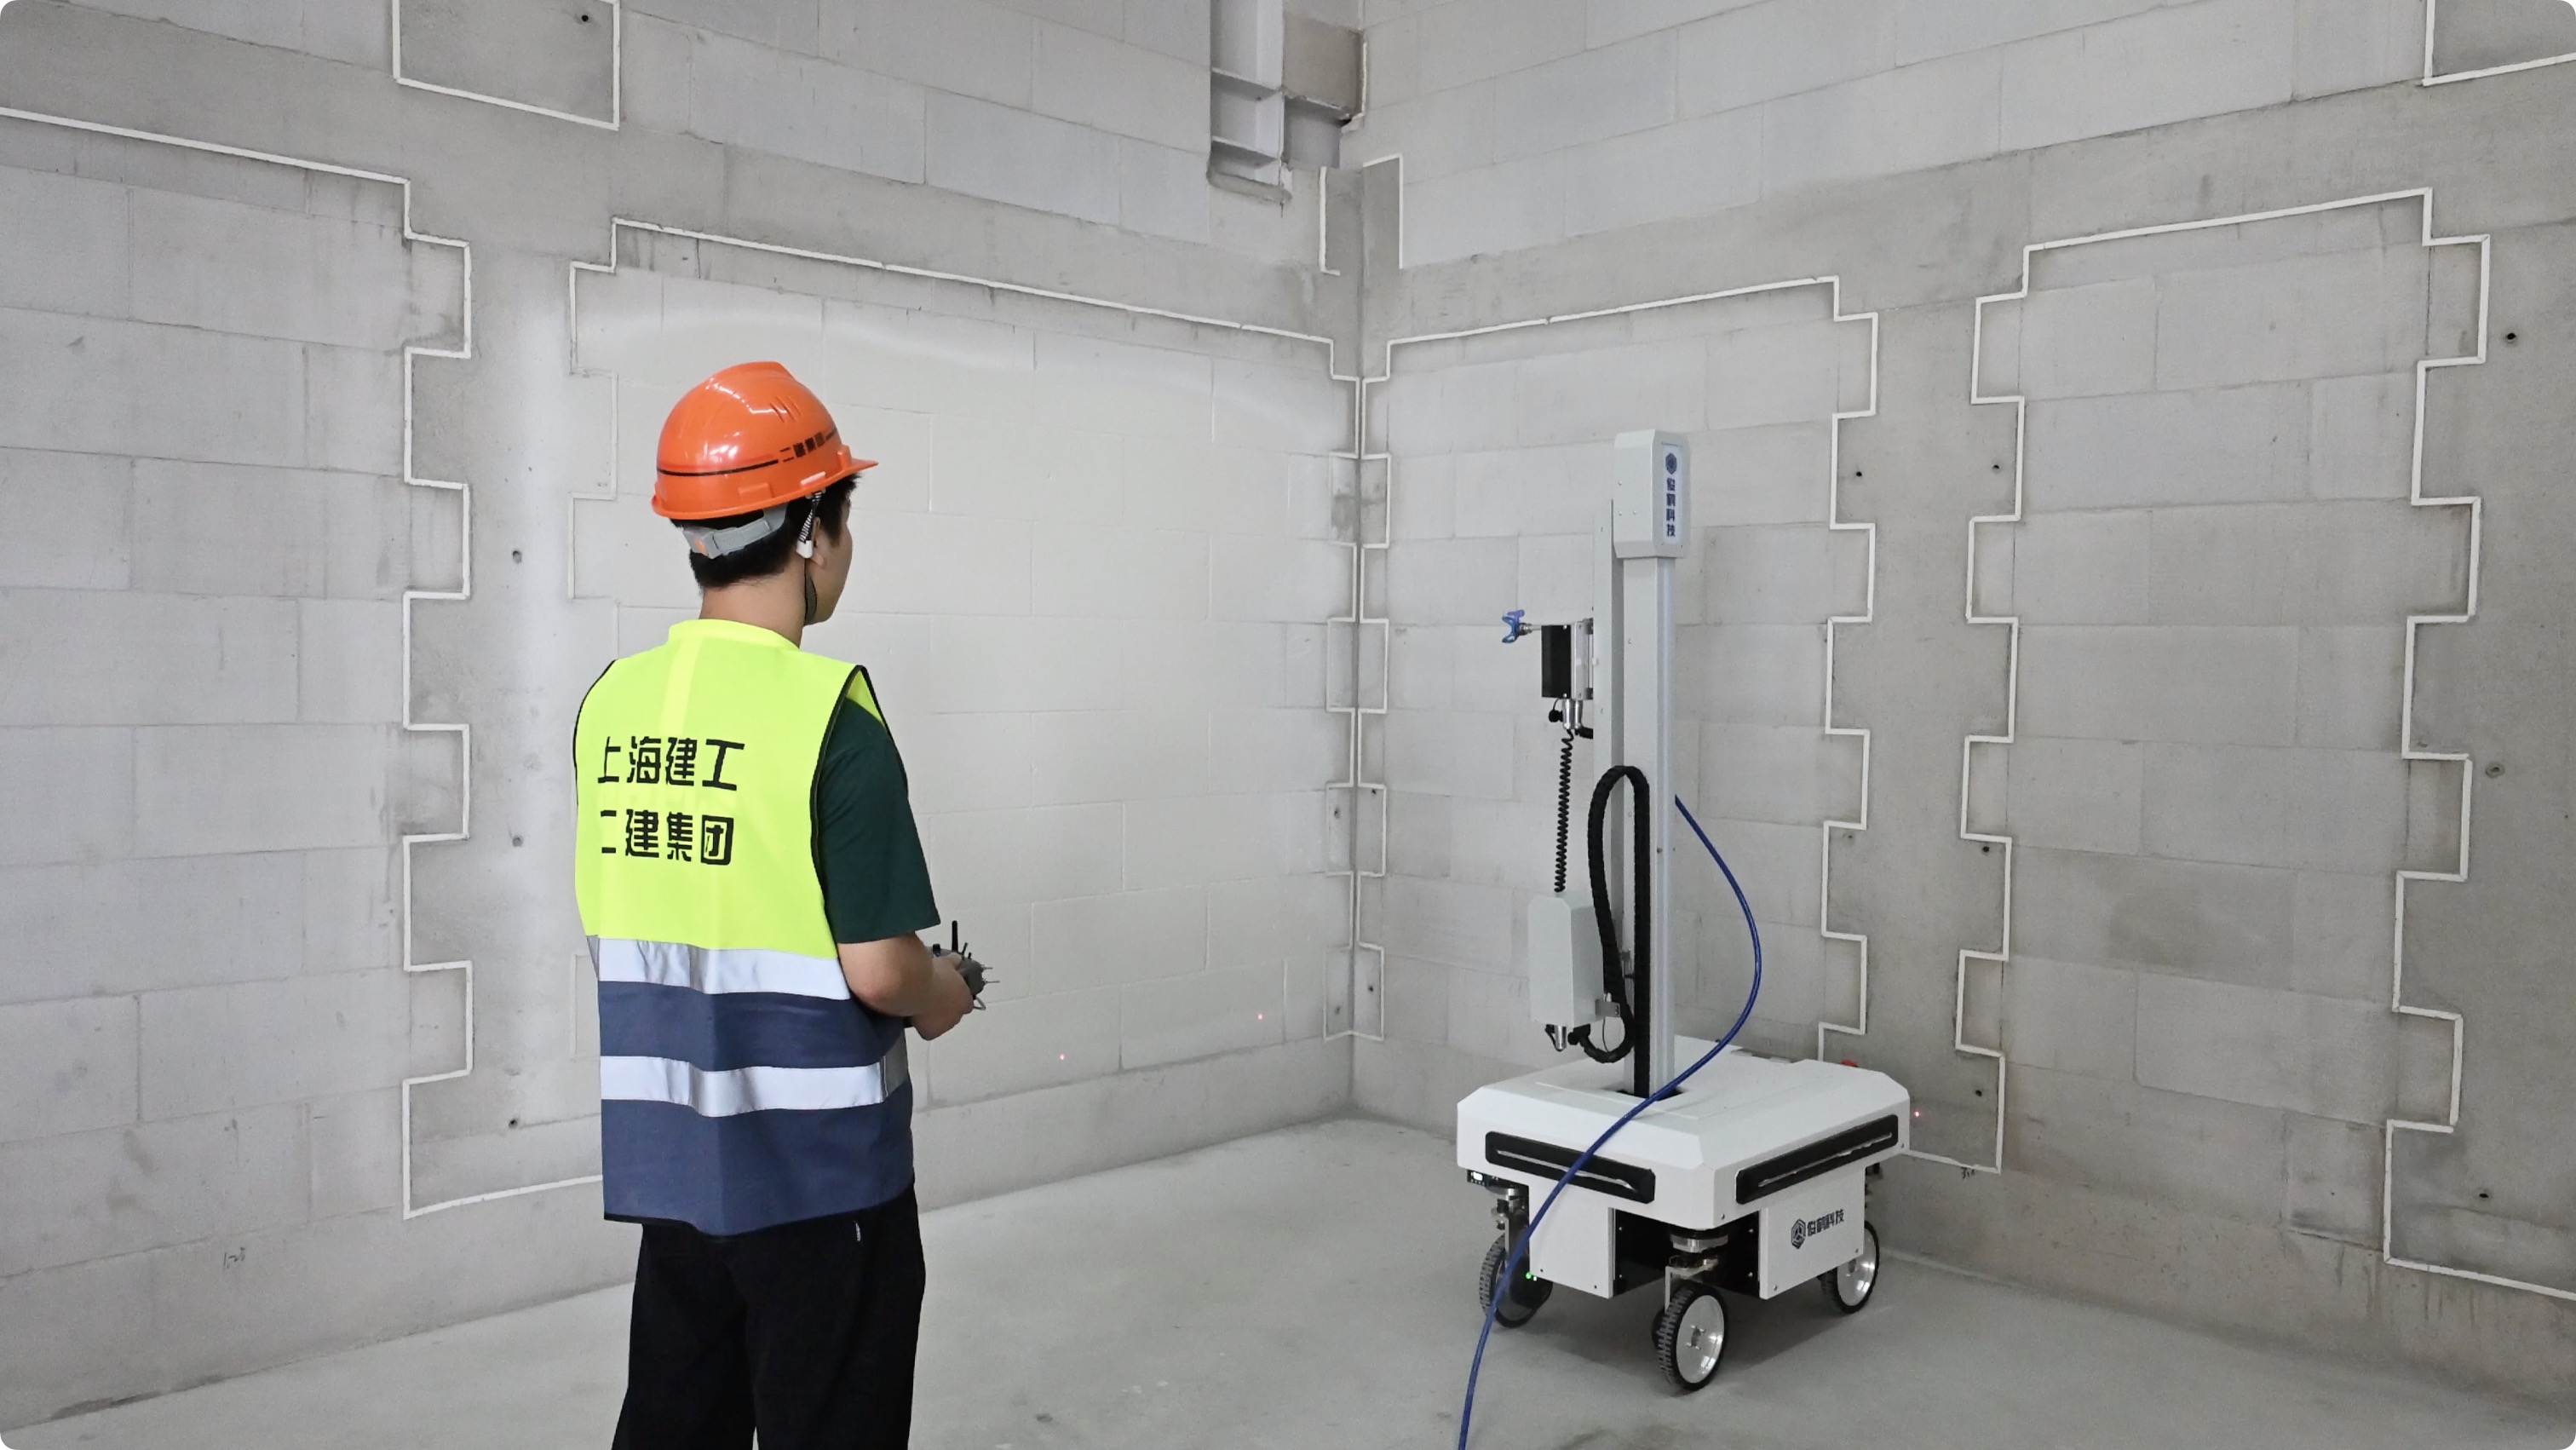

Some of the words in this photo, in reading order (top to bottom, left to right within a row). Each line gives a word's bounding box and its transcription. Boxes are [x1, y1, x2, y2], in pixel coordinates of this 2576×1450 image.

[597, 736, 745, 791] 上海建工
[600, 808, 734, 866] 二建集团
